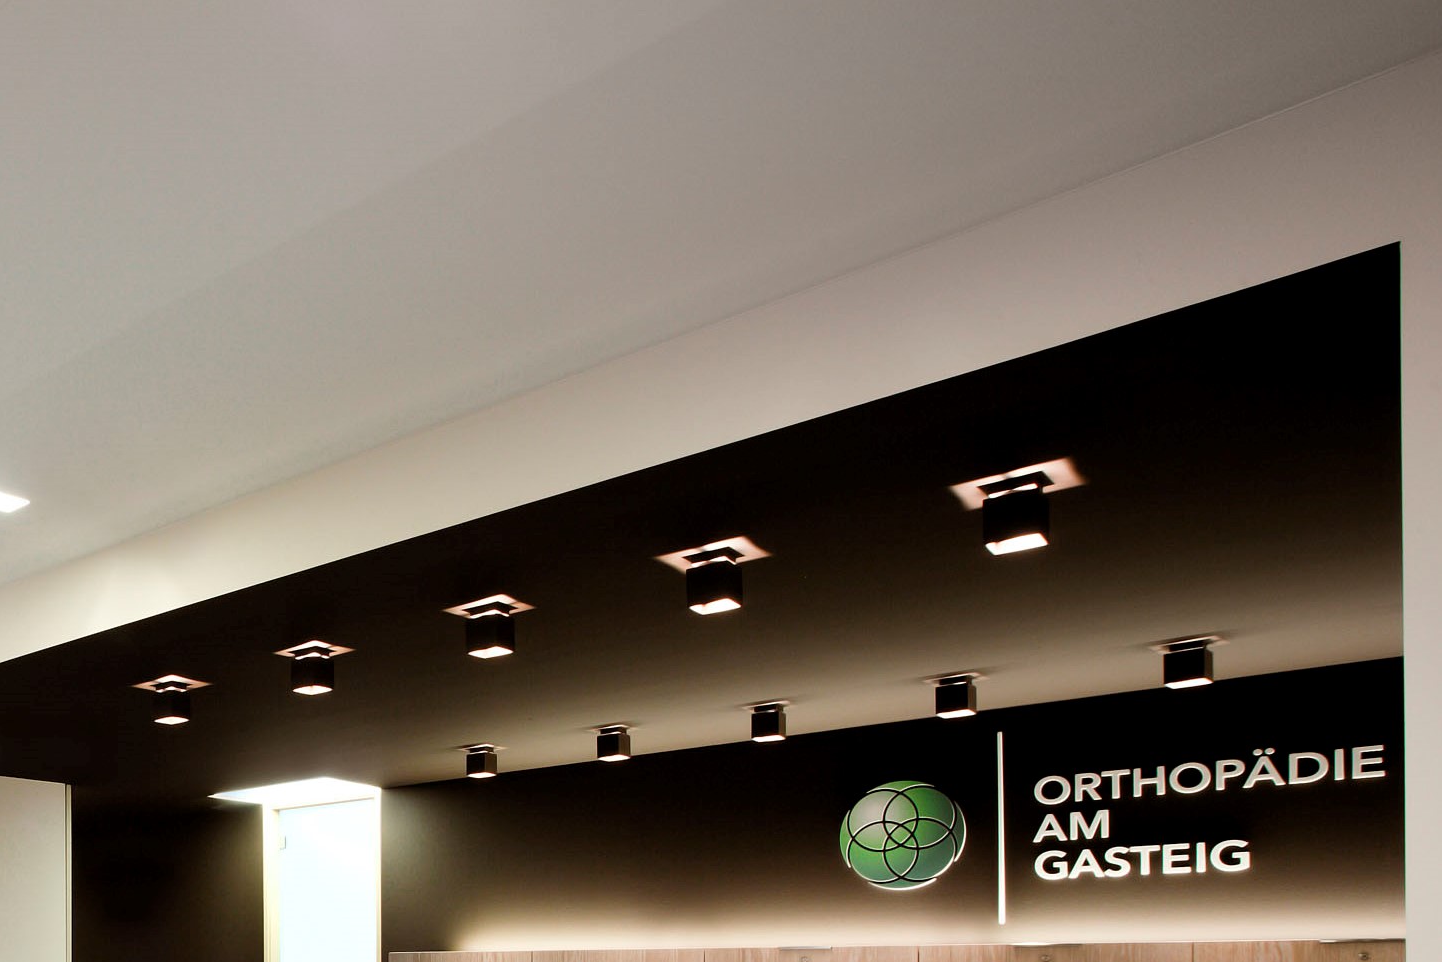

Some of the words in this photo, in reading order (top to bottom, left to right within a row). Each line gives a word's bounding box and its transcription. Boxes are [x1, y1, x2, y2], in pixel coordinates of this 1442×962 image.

[1033, 744, 1386, 805] ORTHOPÄDIE
[1033, 809, 1110, 843] AM
[1033, 839, 1251, 881] GASTEIG
